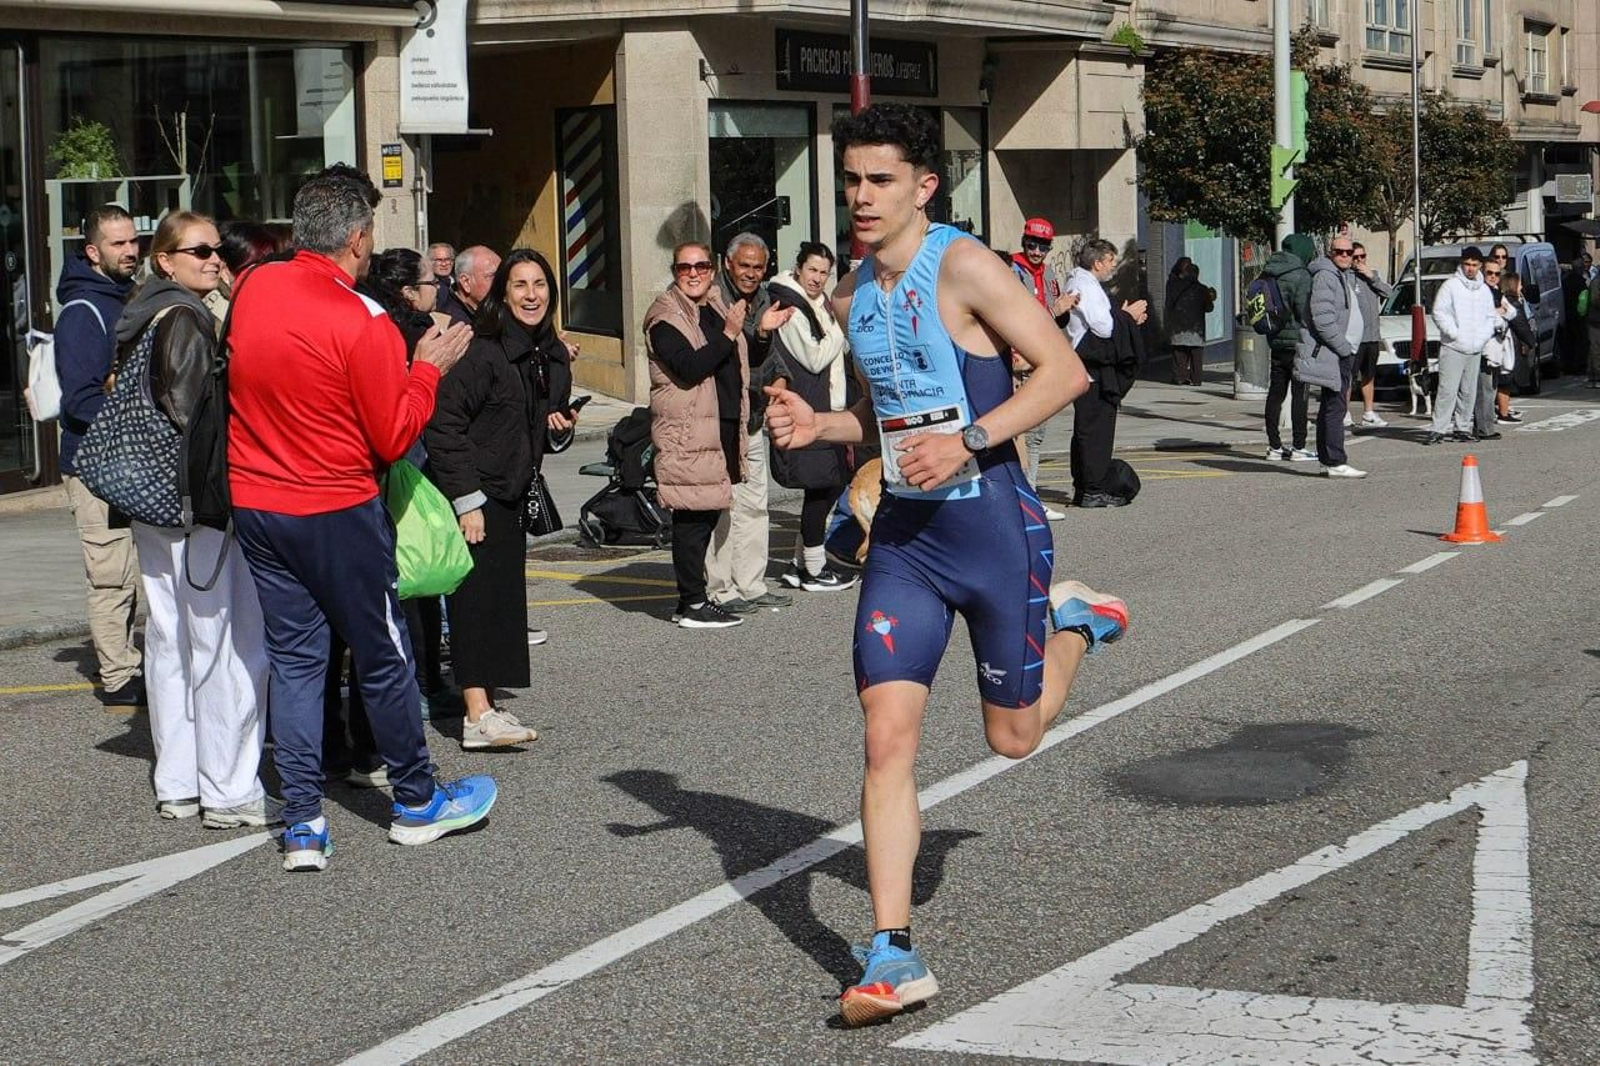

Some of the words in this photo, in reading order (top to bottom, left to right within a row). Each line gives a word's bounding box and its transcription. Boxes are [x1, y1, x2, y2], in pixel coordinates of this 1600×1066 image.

[800, 47, 841, 74] PACHECO
[863, 352, 904, 366] CONCELLO
[870, 367, 882, 376] DE
